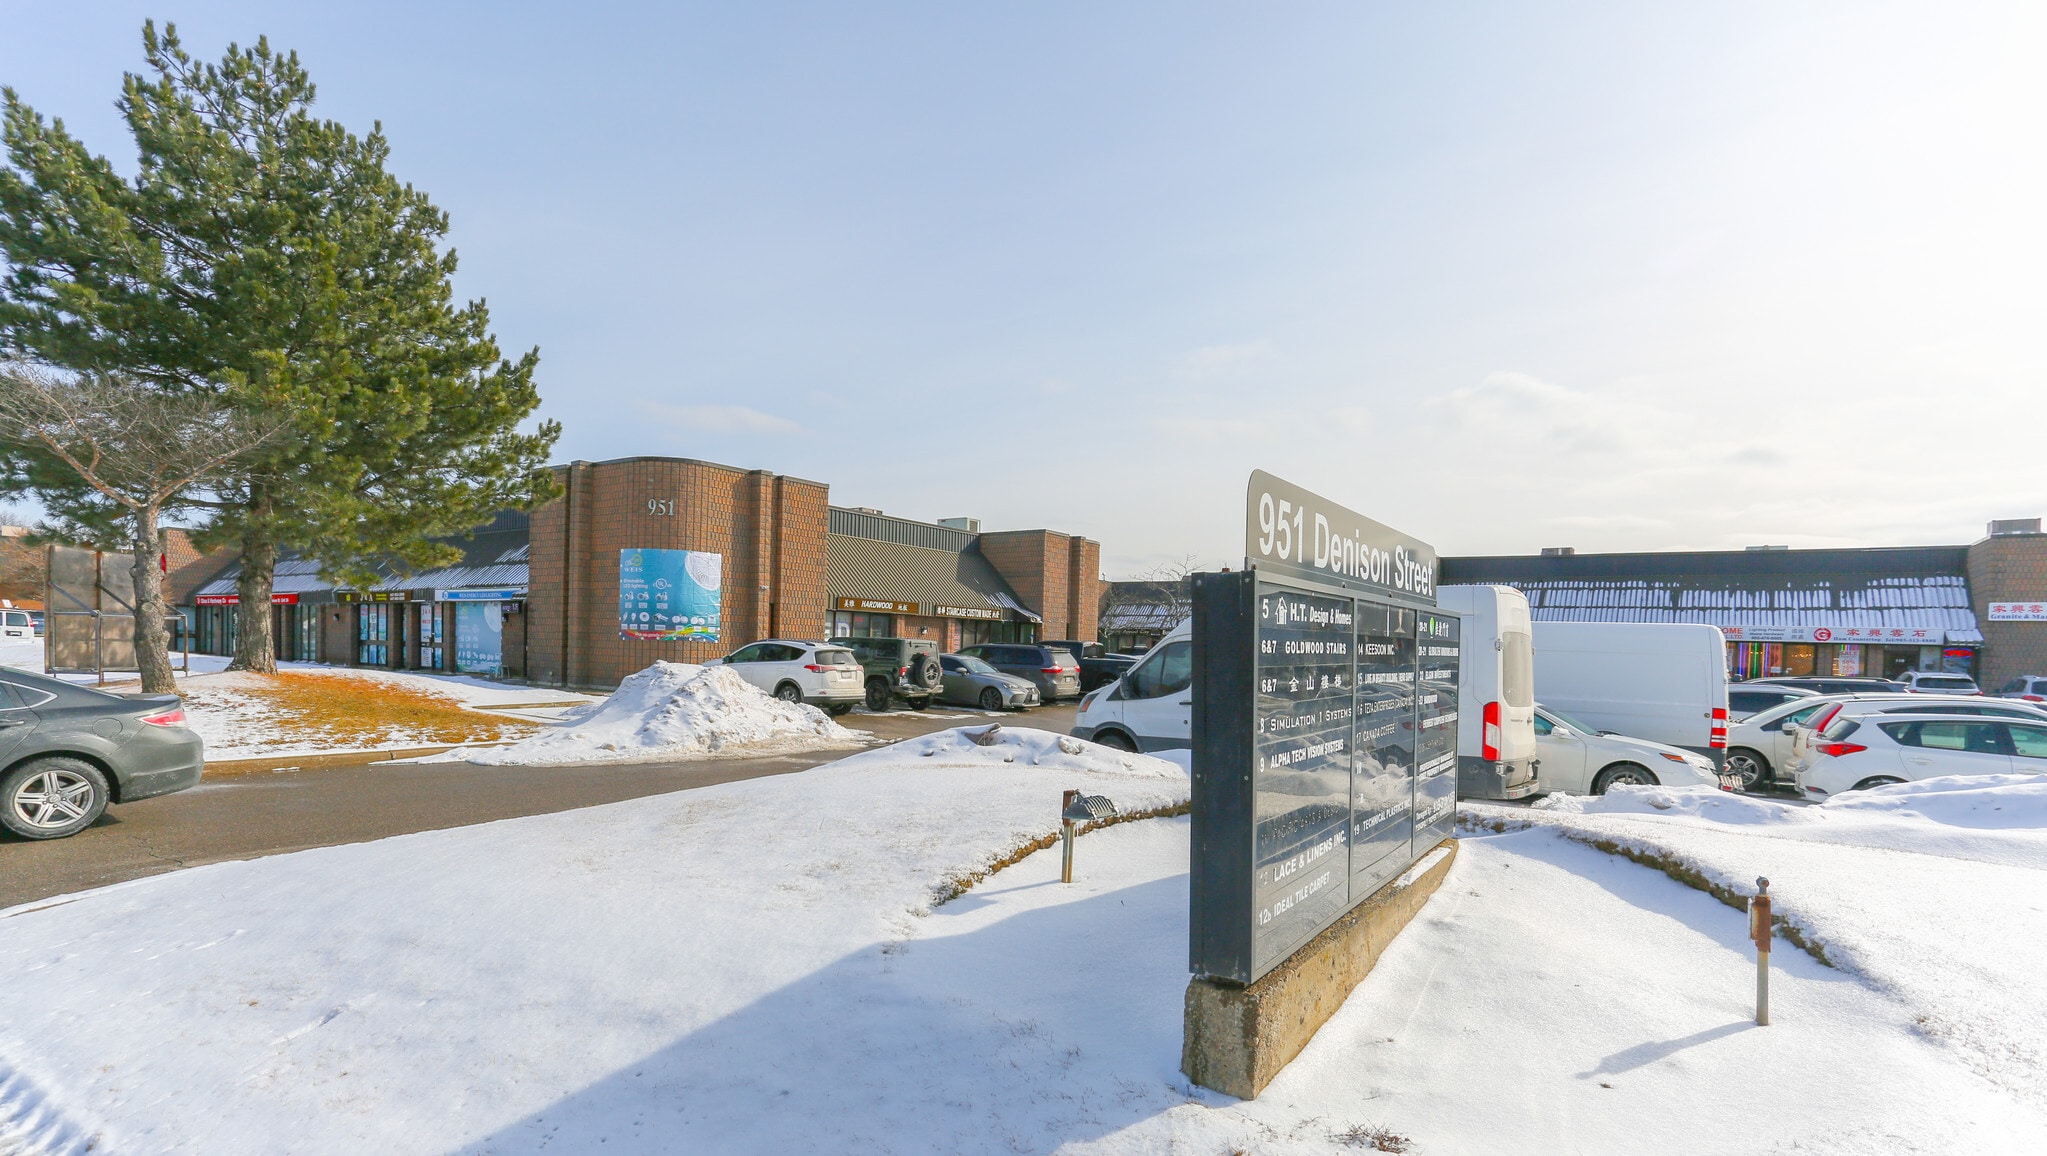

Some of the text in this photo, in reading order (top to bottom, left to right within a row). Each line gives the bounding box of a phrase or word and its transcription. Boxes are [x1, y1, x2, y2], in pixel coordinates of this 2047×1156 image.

[648, 498, 675, 516] 951
[1259, 492, 1433, 597] 951 Denison Street
[861, 600, 894, 610] HARDWOOD
[946, 605, 967, 617] STAIRCASE
[967, 607, 982, 618] CUSTOM
[982, 608, 992, 619] MADE
[1262, 598, 1352, 627] 5 H.T. Design & Homes
[1261, 639, 1347, 655] 6&7 GOLDWOOD STAIRS
[1261, 679, 1277, 693] 6&7
[1260, 717, 1265, 733] 8
[1260, 738, 1344, 773] 9 ALPHA TECH VISION SYSTEMS
[1273, 858, 1297, 882] LACE
[1299, 854, 1305, 869] &
[1306, 837, 1333, 864] LINENS
[1333, 830, 1346, 848] INC.
[1273, 895, 1294, 917] IDEAL
[1295, 886, 1309, 903] TILE
[1309, 871, 1331, 895] CARPET
